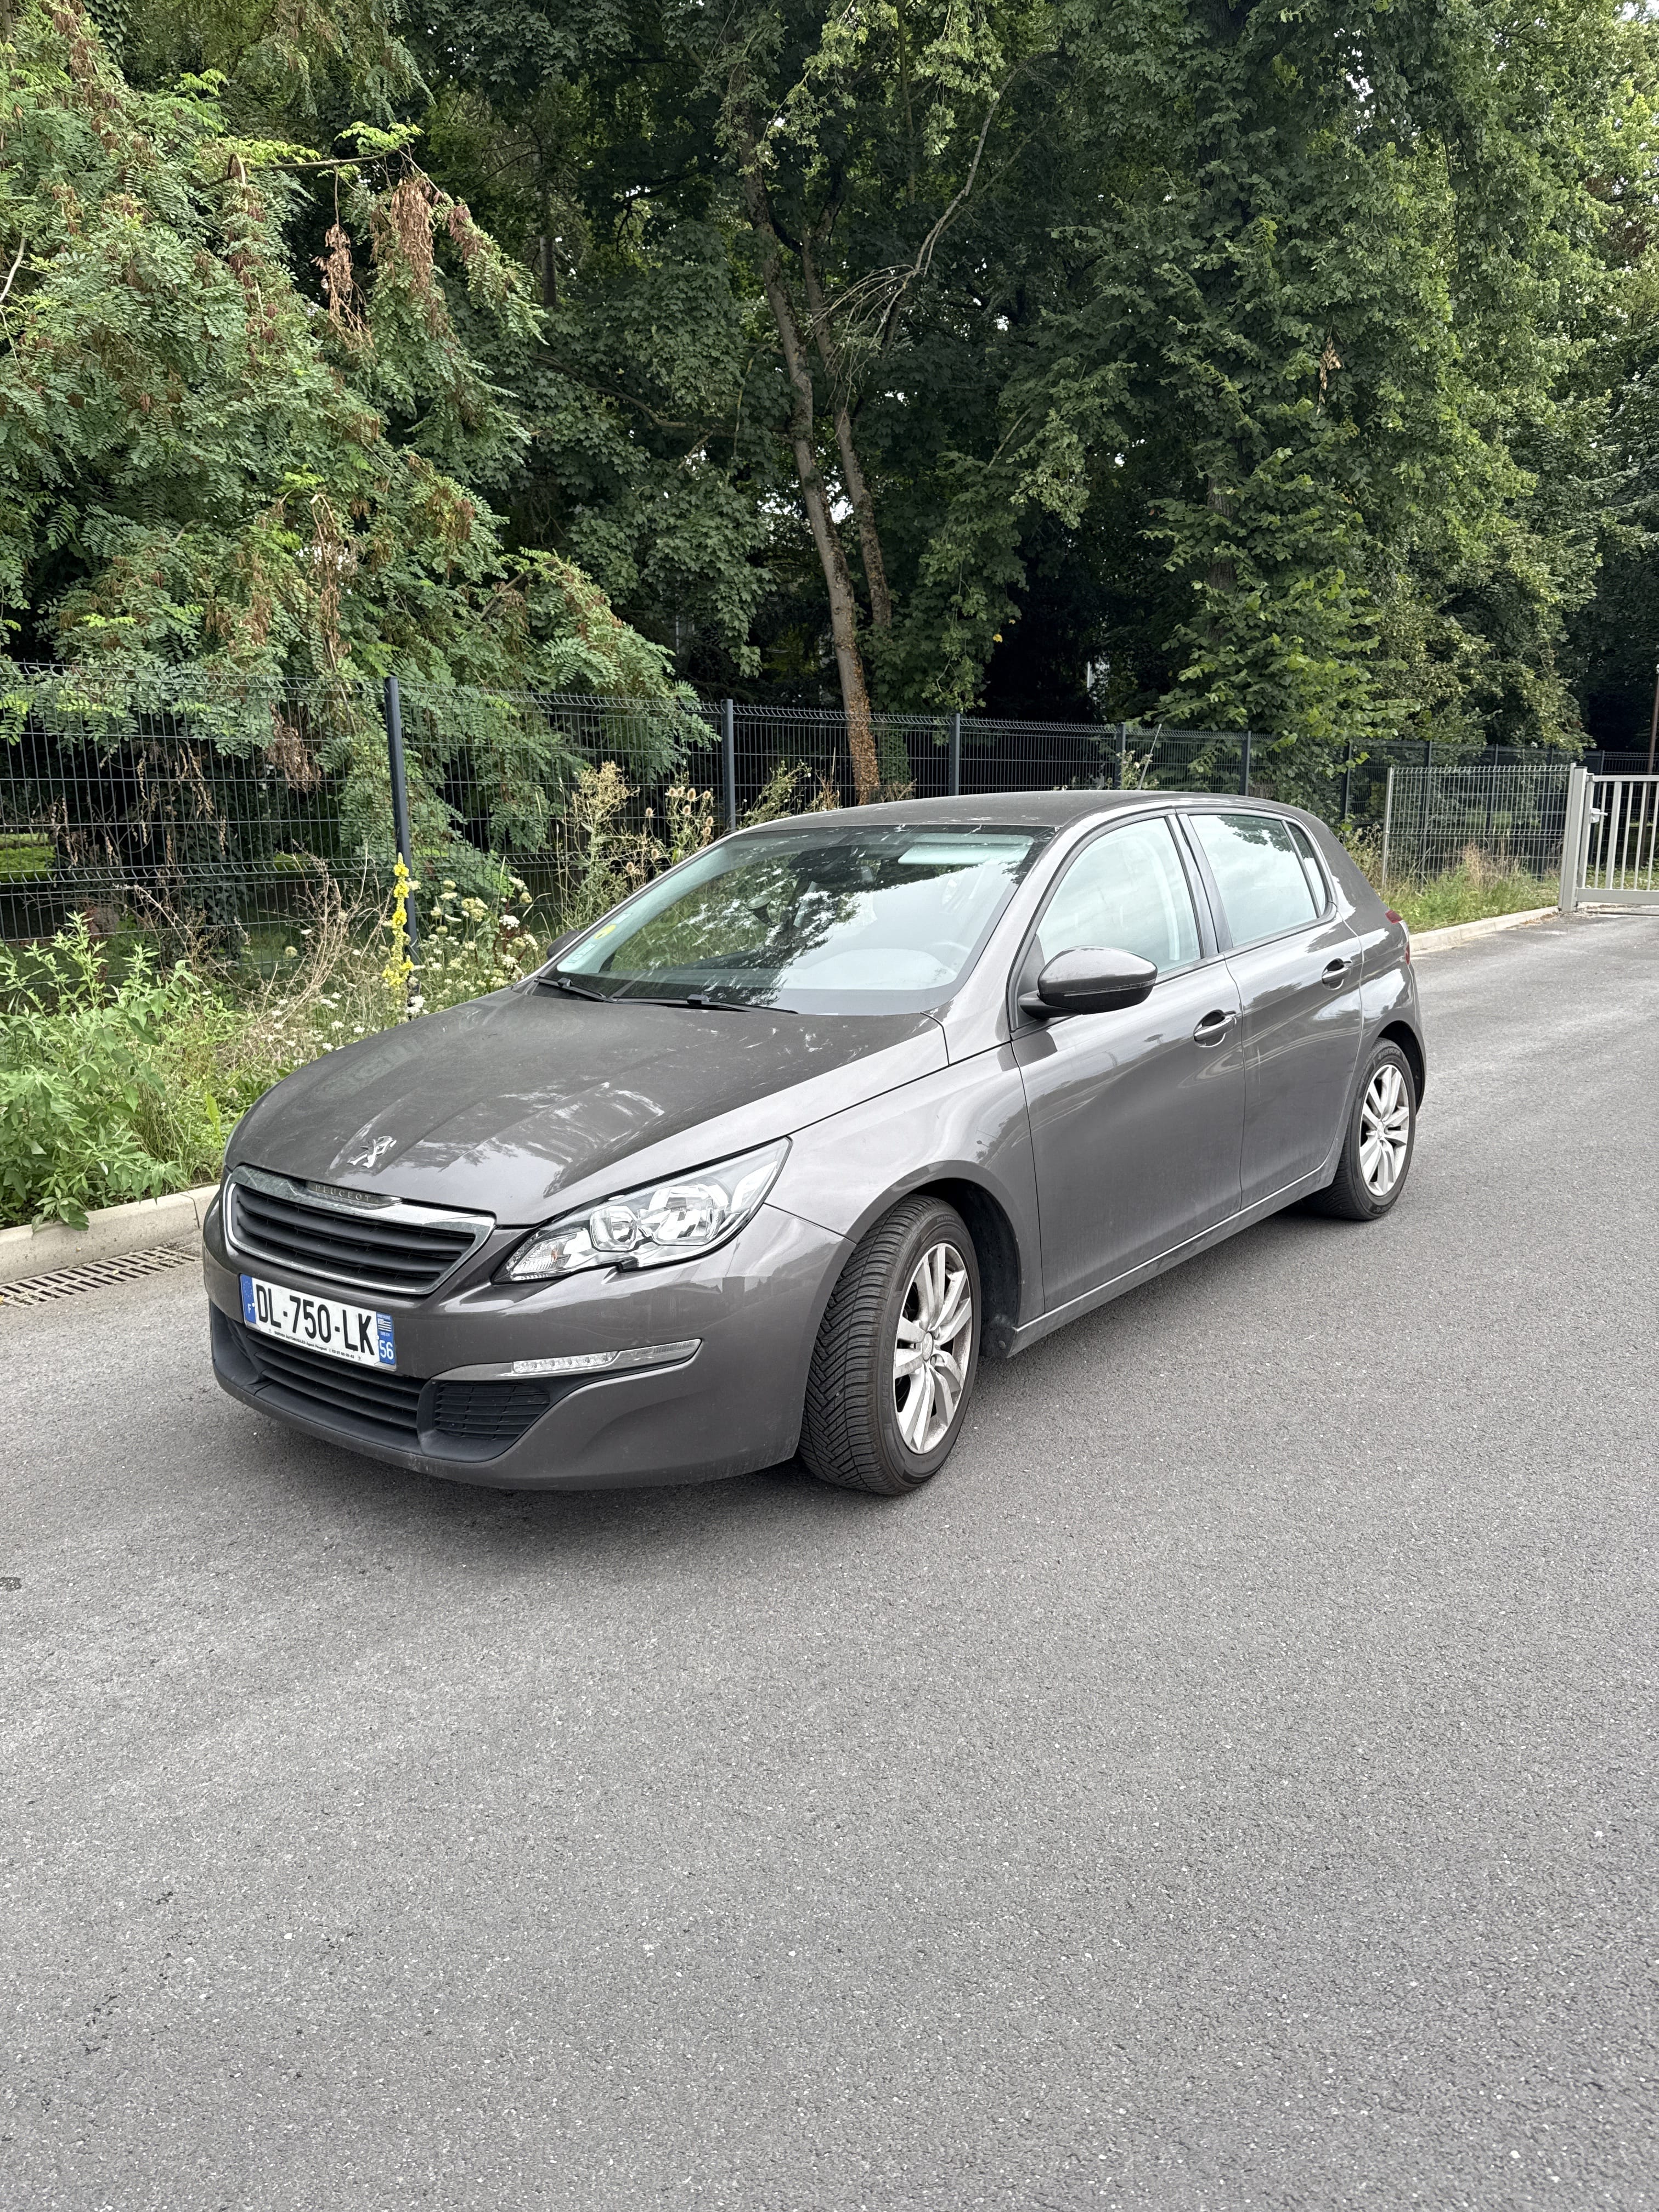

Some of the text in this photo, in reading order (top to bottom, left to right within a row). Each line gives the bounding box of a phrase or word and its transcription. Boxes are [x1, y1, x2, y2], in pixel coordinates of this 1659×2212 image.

[315, 1184, 371, 1202] PEUGEOT
[247, 1303, 252, 1313] F
[256, 1284, 375, 1356] DL-750-LK
[379, 1339, 394, 1360] 56
